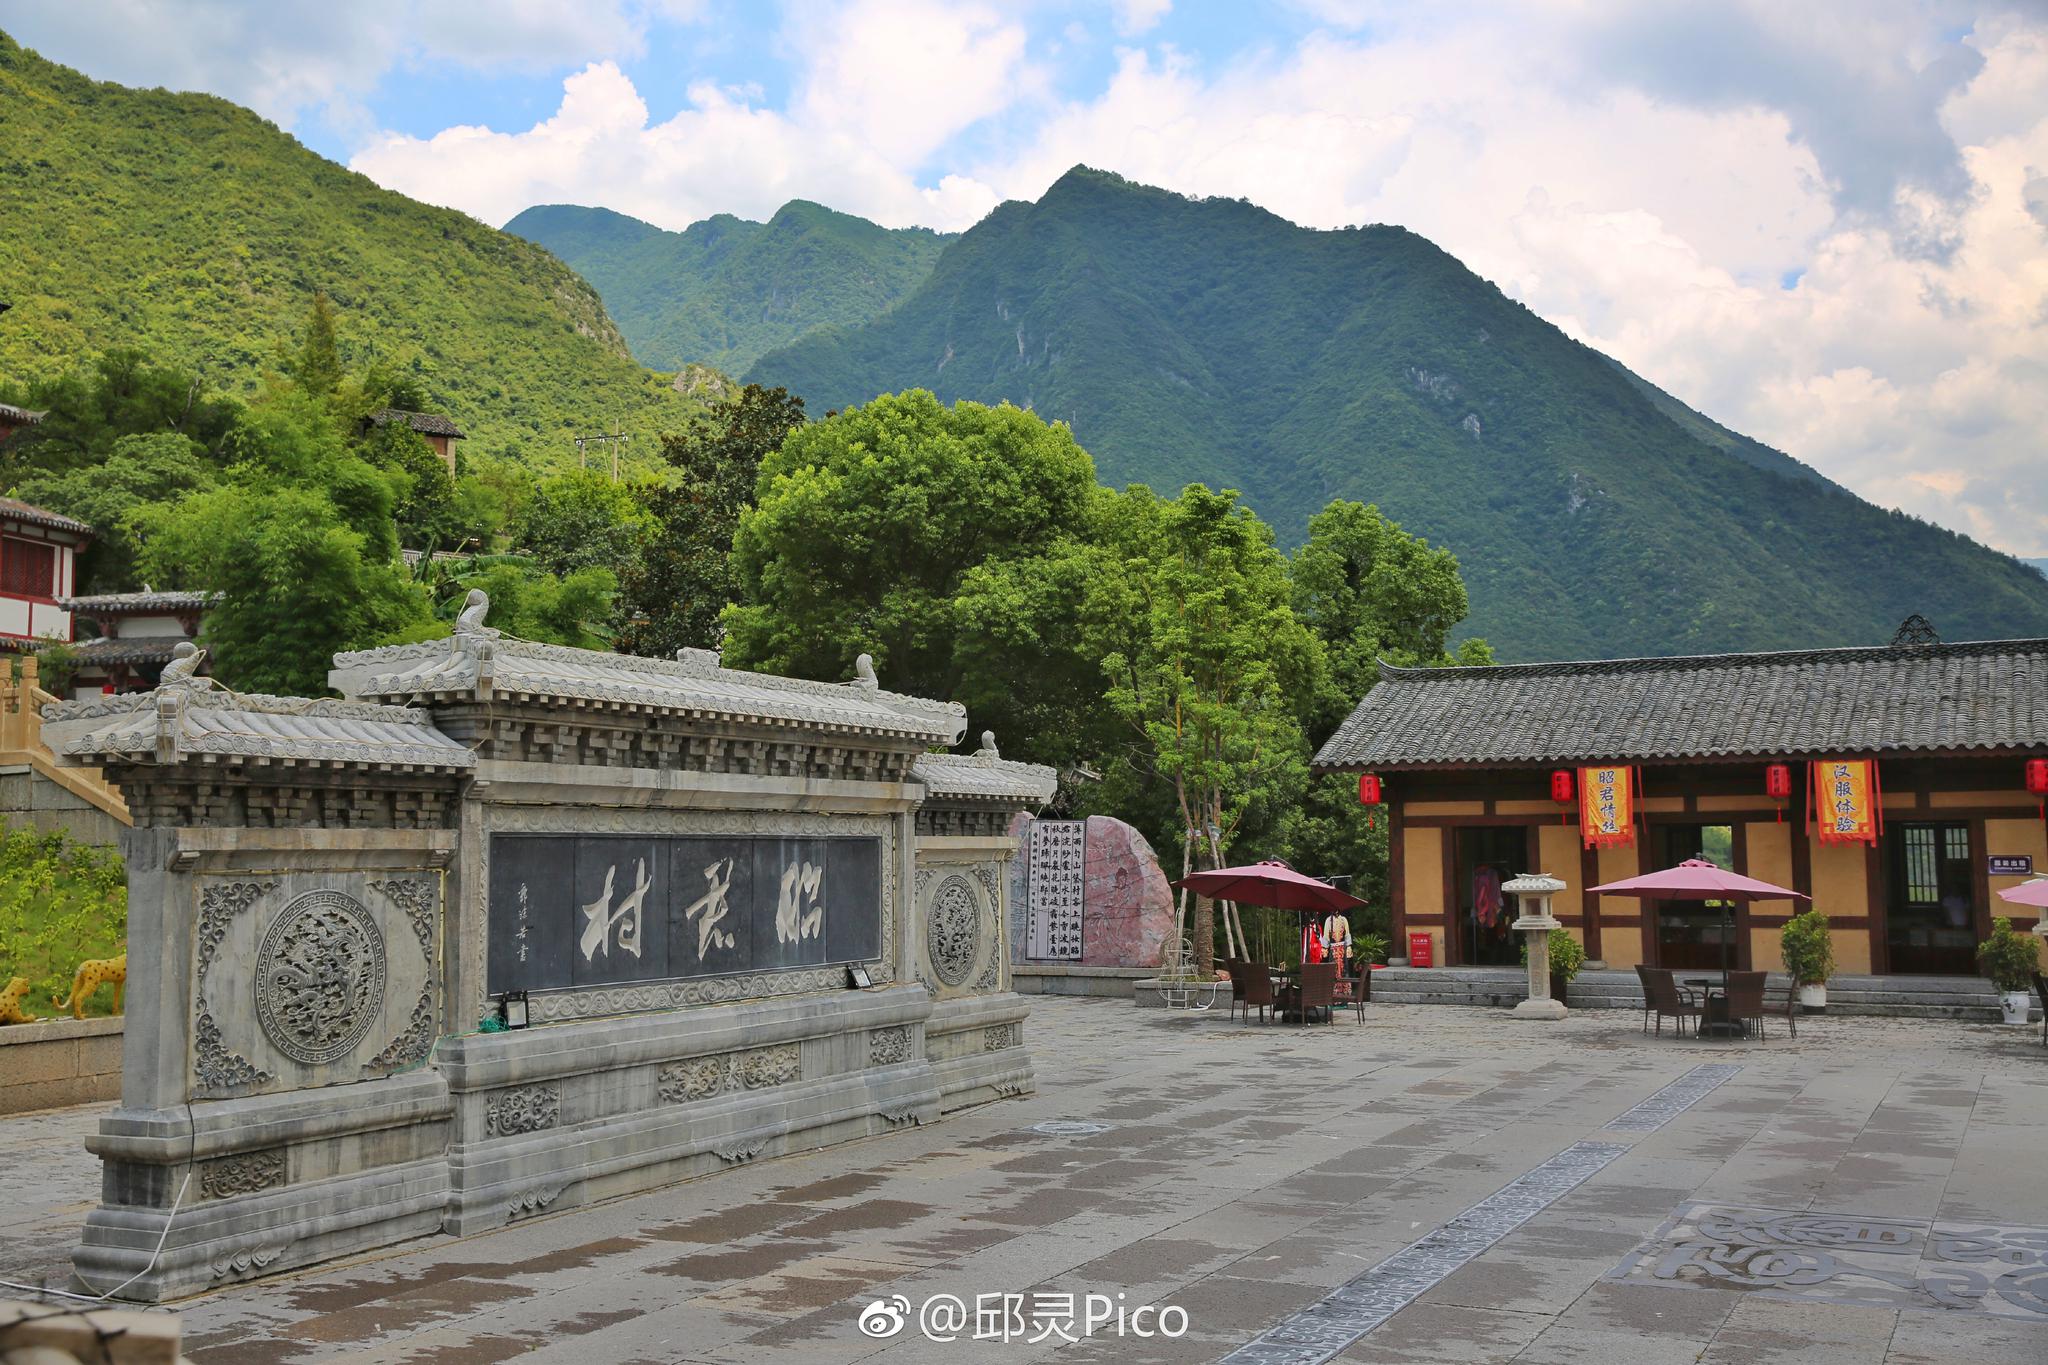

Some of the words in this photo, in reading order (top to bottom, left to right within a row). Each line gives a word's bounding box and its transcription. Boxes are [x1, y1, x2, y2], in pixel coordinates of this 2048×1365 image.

[1599, 770, 1619, 833] 昭君情丝
[1834, 764, 1856, 832] 汉服体验
